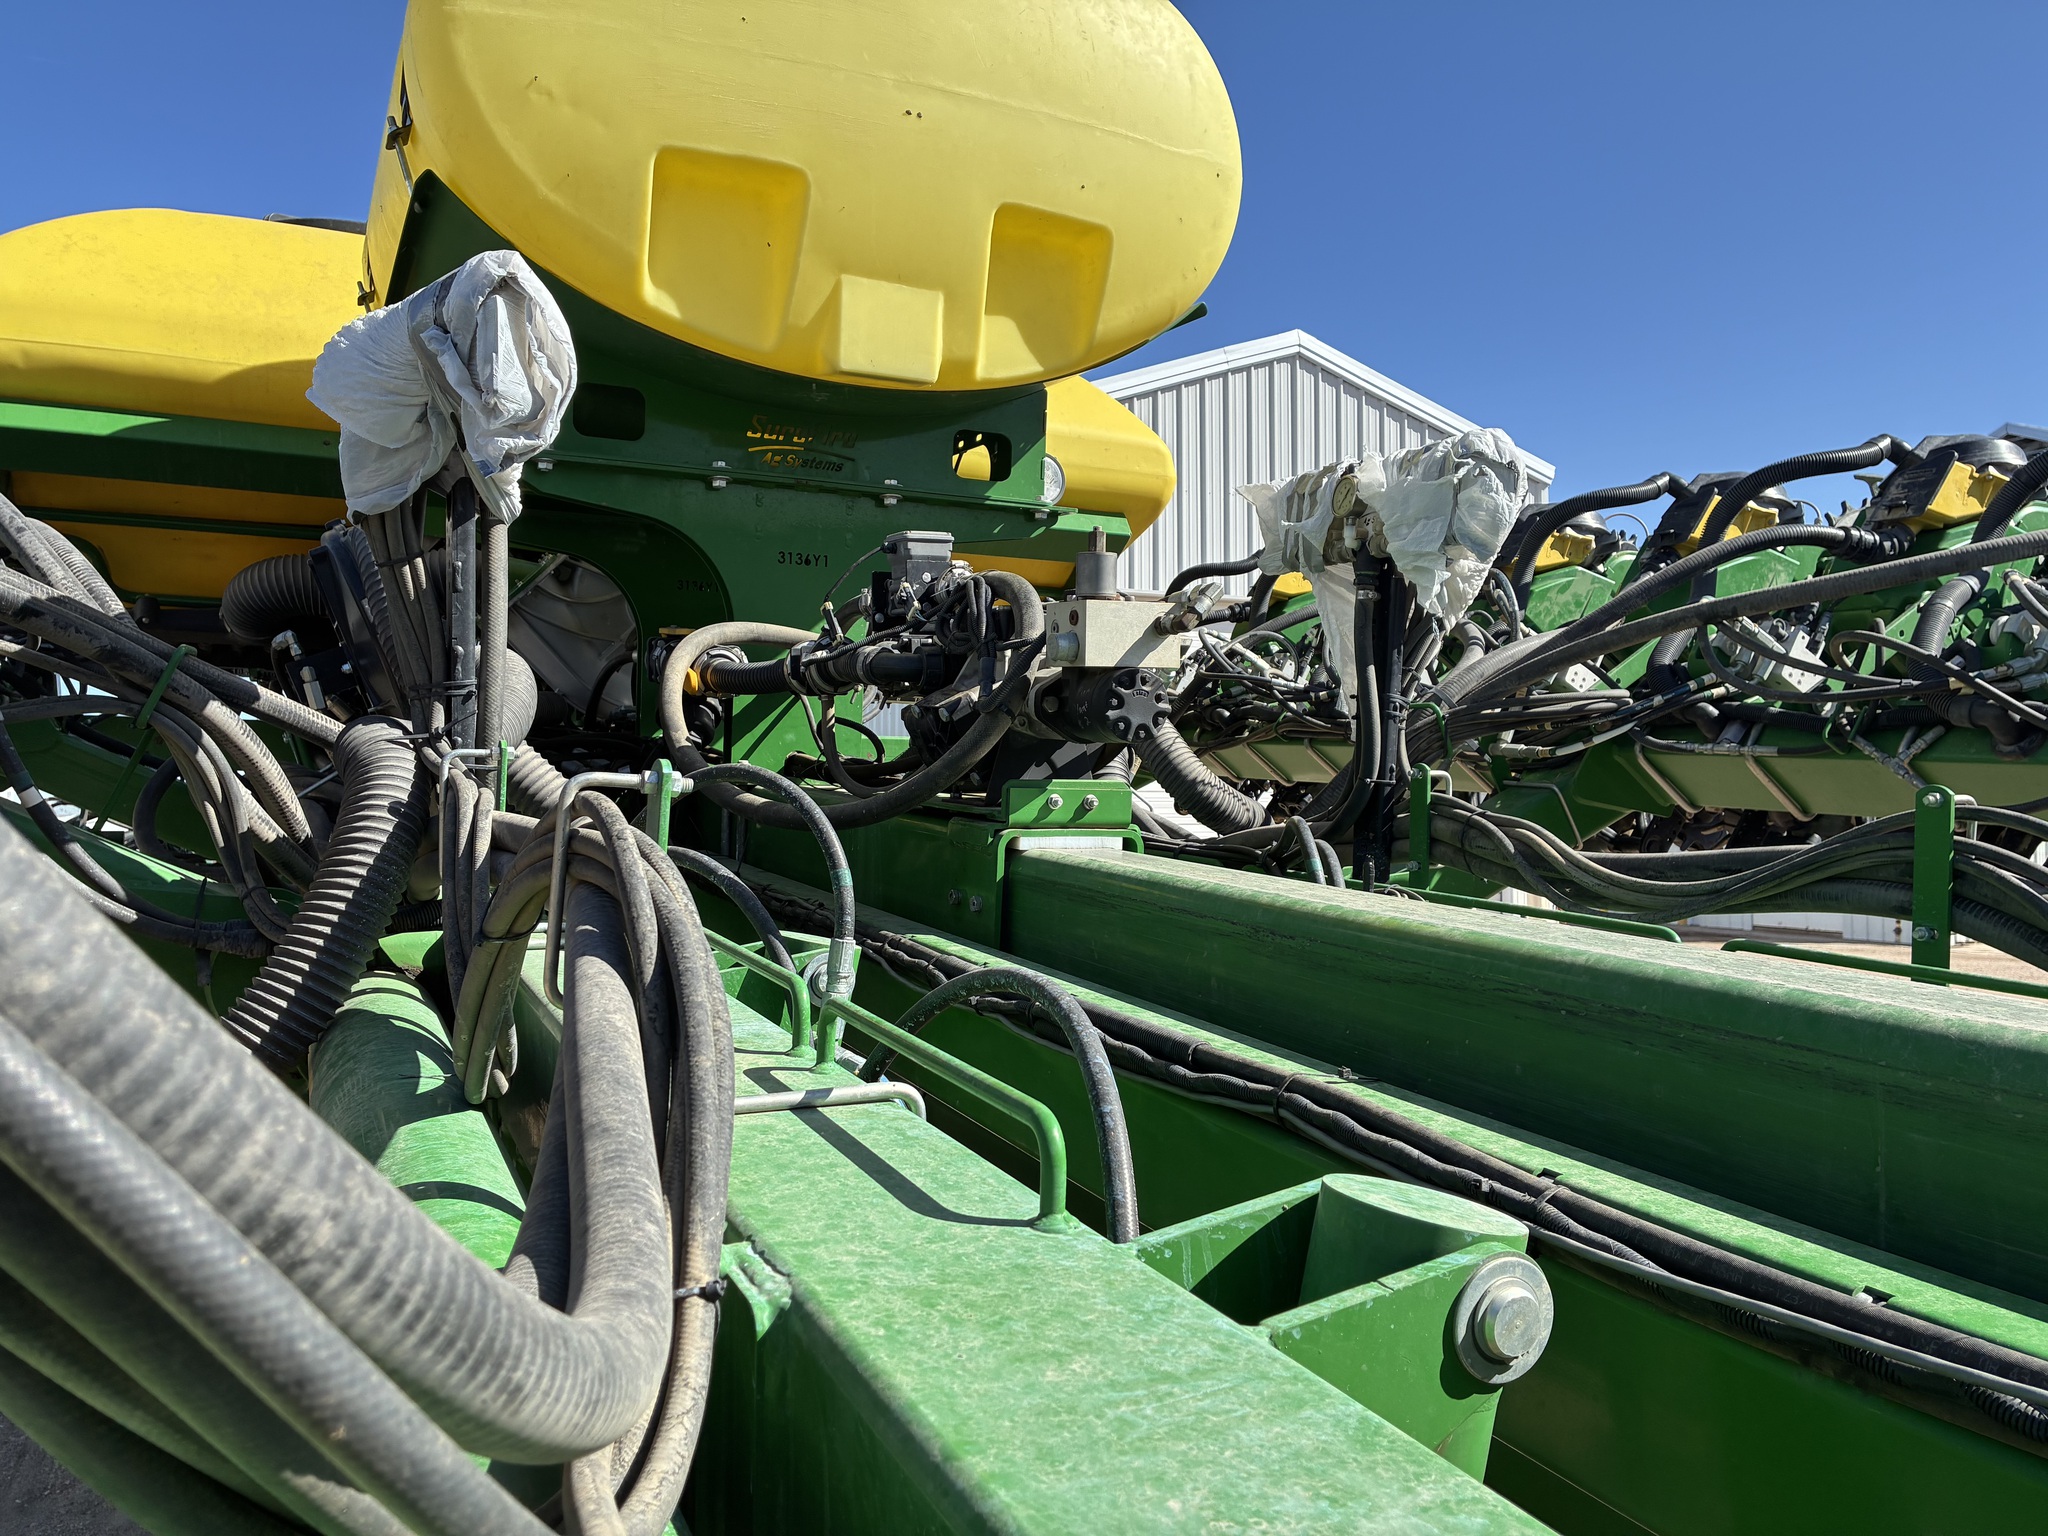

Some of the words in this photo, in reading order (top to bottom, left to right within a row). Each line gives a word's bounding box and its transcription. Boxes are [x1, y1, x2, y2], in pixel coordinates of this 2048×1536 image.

[761, 451, 783, 468] Ag
[784, 454, 845, 473] Systems
[777, 550, 828, 568] 3136Y1
